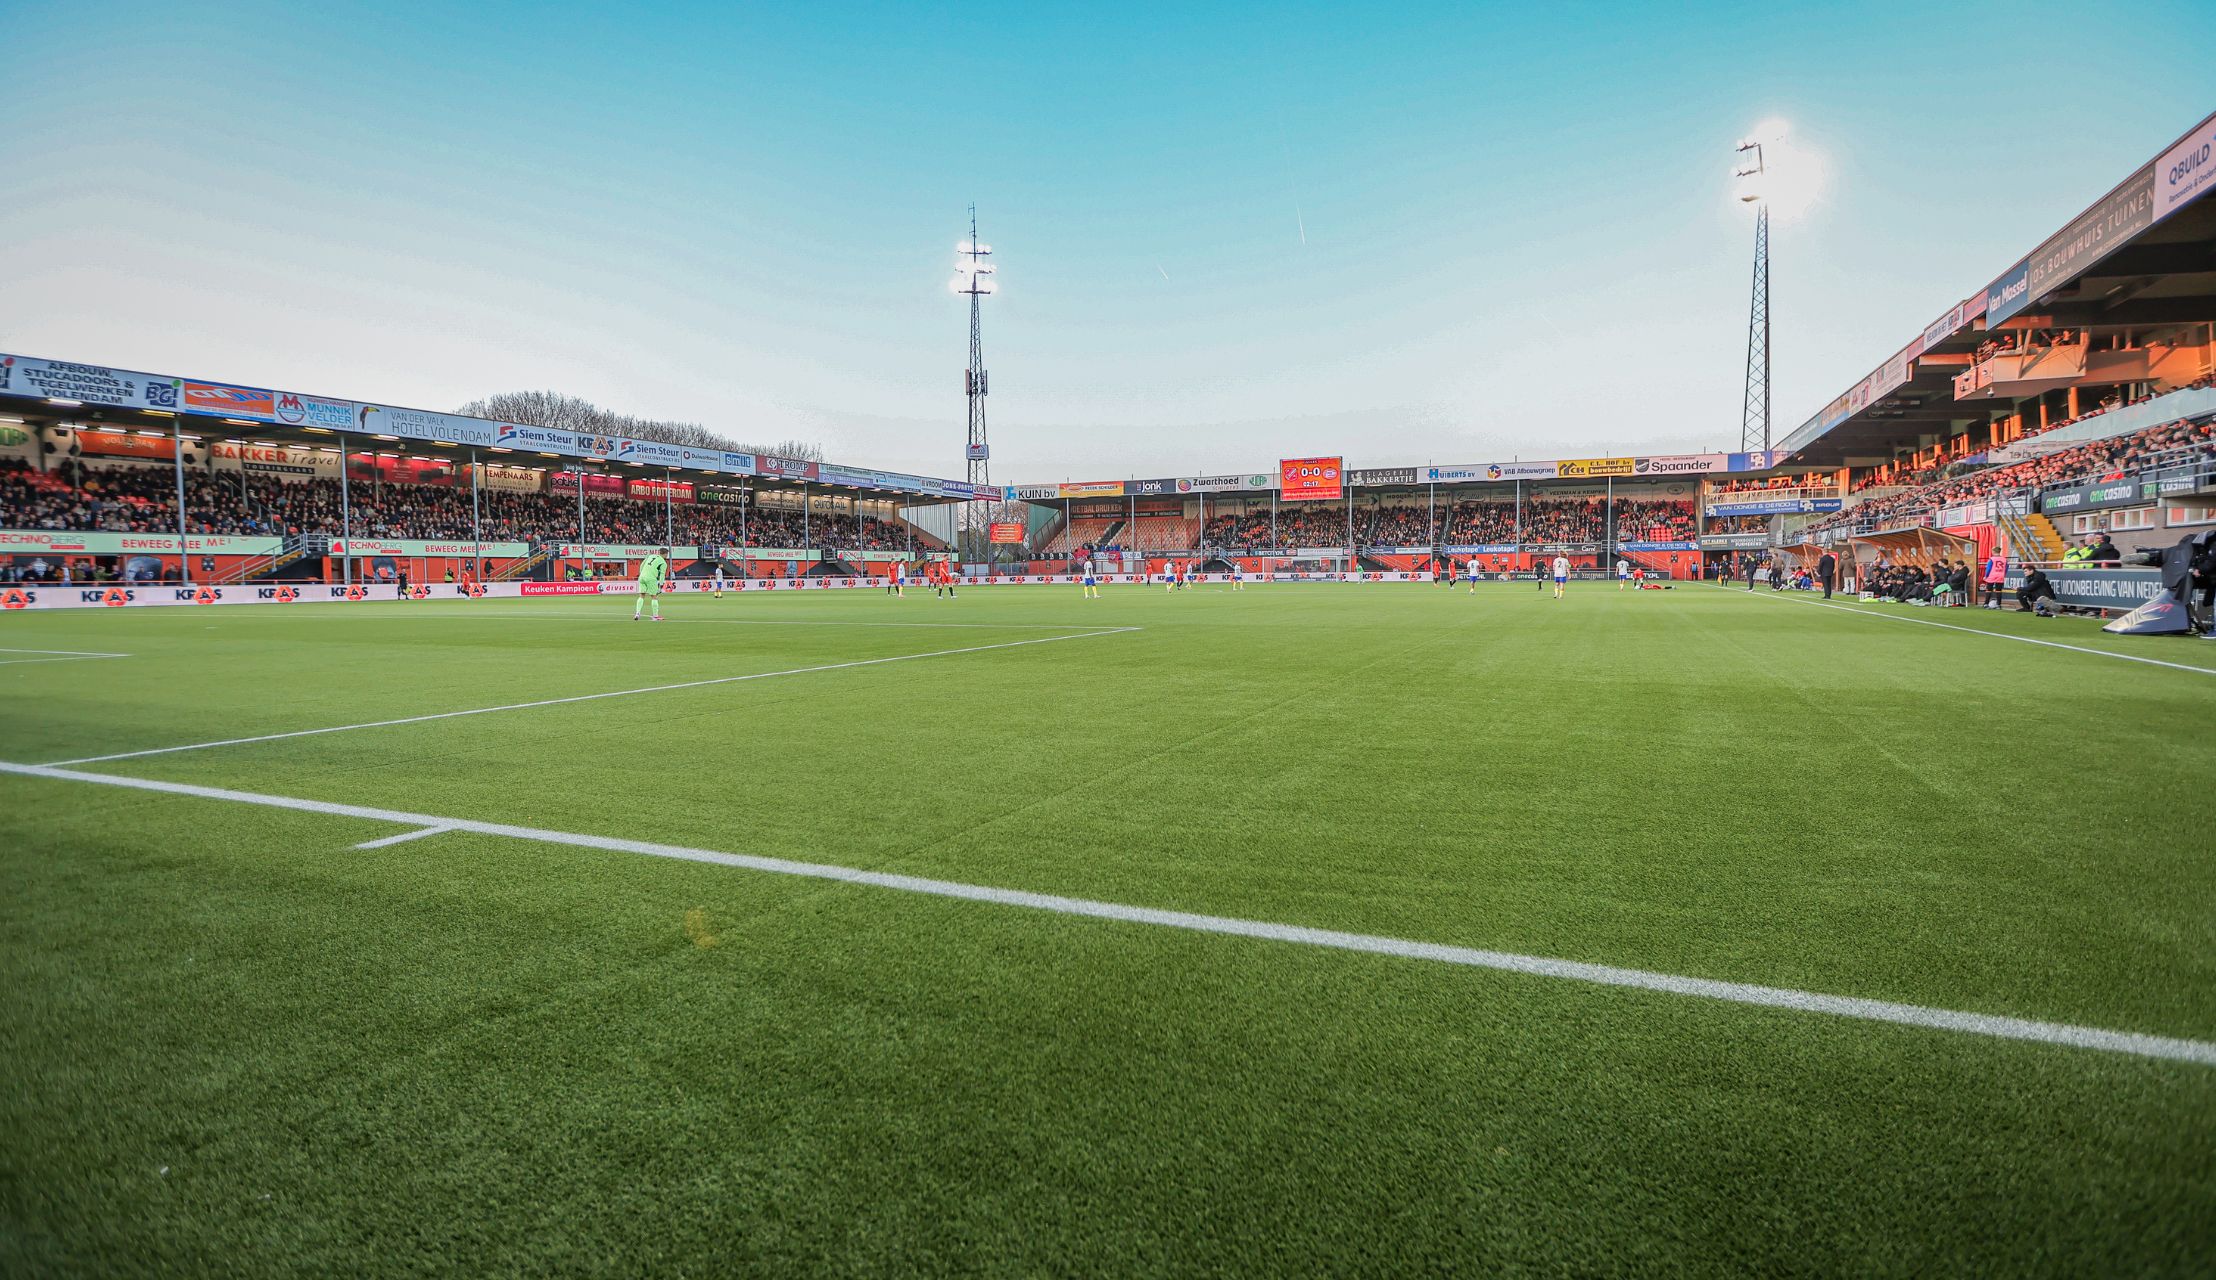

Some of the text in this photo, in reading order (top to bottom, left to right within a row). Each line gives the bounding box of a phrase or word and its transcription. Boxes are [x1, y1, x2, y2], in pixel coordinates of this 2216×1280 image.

[2168, 143, 2210, 186] QBUILD
[2047, 223, 2103, 274] BOUWHUIS
[2107, 185, 2154, 233] TUINEN
[23, 367, 120, 387] STUCADOORS
[124, 380, 135, 389] &
[28, 377, 135, 397] TEGELWERKEN
[41, 387, 124, 404] VOLENDAM
[308, 403, 352, 416] MUNNIK
[308, 412, 352, 424] VELDER
[391, 411, 445, 426] VAN DER VALK
[392, 421, 491, 444] HOTEL VOLENDAM
[519, 429, 544, 441] Siem
[546, 432, 573, 444] Steur
[519, 440, 574, 451] STAALCONSTRUCTIES
[636, 444, 657, 455] Siem
[658, 446, 680, 458] Steur
[212, 444, 340, 466] BAKKER Travel
[779, 460, 809, 472] TROMP
[1589, 466, 1632, 474] bouwbedrijf
[1651, 460, 1712, 473] Spaander
[1193, 477, 1239, 487] Zwarthoed
[1366, 475, 1414, 484] BAKKERTJE
[630, 484, 692, 499] ARBO ROTTERDAM
[1018, 489, 1056, 499] KUIN bv
[2090, 483, 2132, 503] onecasino
[2045, 492, 2081, 509] onecasino
[122, 539, 172, 549] BEWEEG
[425, 545, 457, 553] BEWEEG
[1447, 545, 1515, 554] Leukotape Leukotape
[175, 588, 223, 603] KRAS
[258, 587, 300, 601] KRAS
[330, 586, 368, 599] KRAS
[524, 584, 634, 593] Keuken Kampioen divisie
[2060, 580, 2117, 597] WOONBELEVING
[2117, 581, 2134, 598] VAN
[81, 589, 135, 604] KRAS
